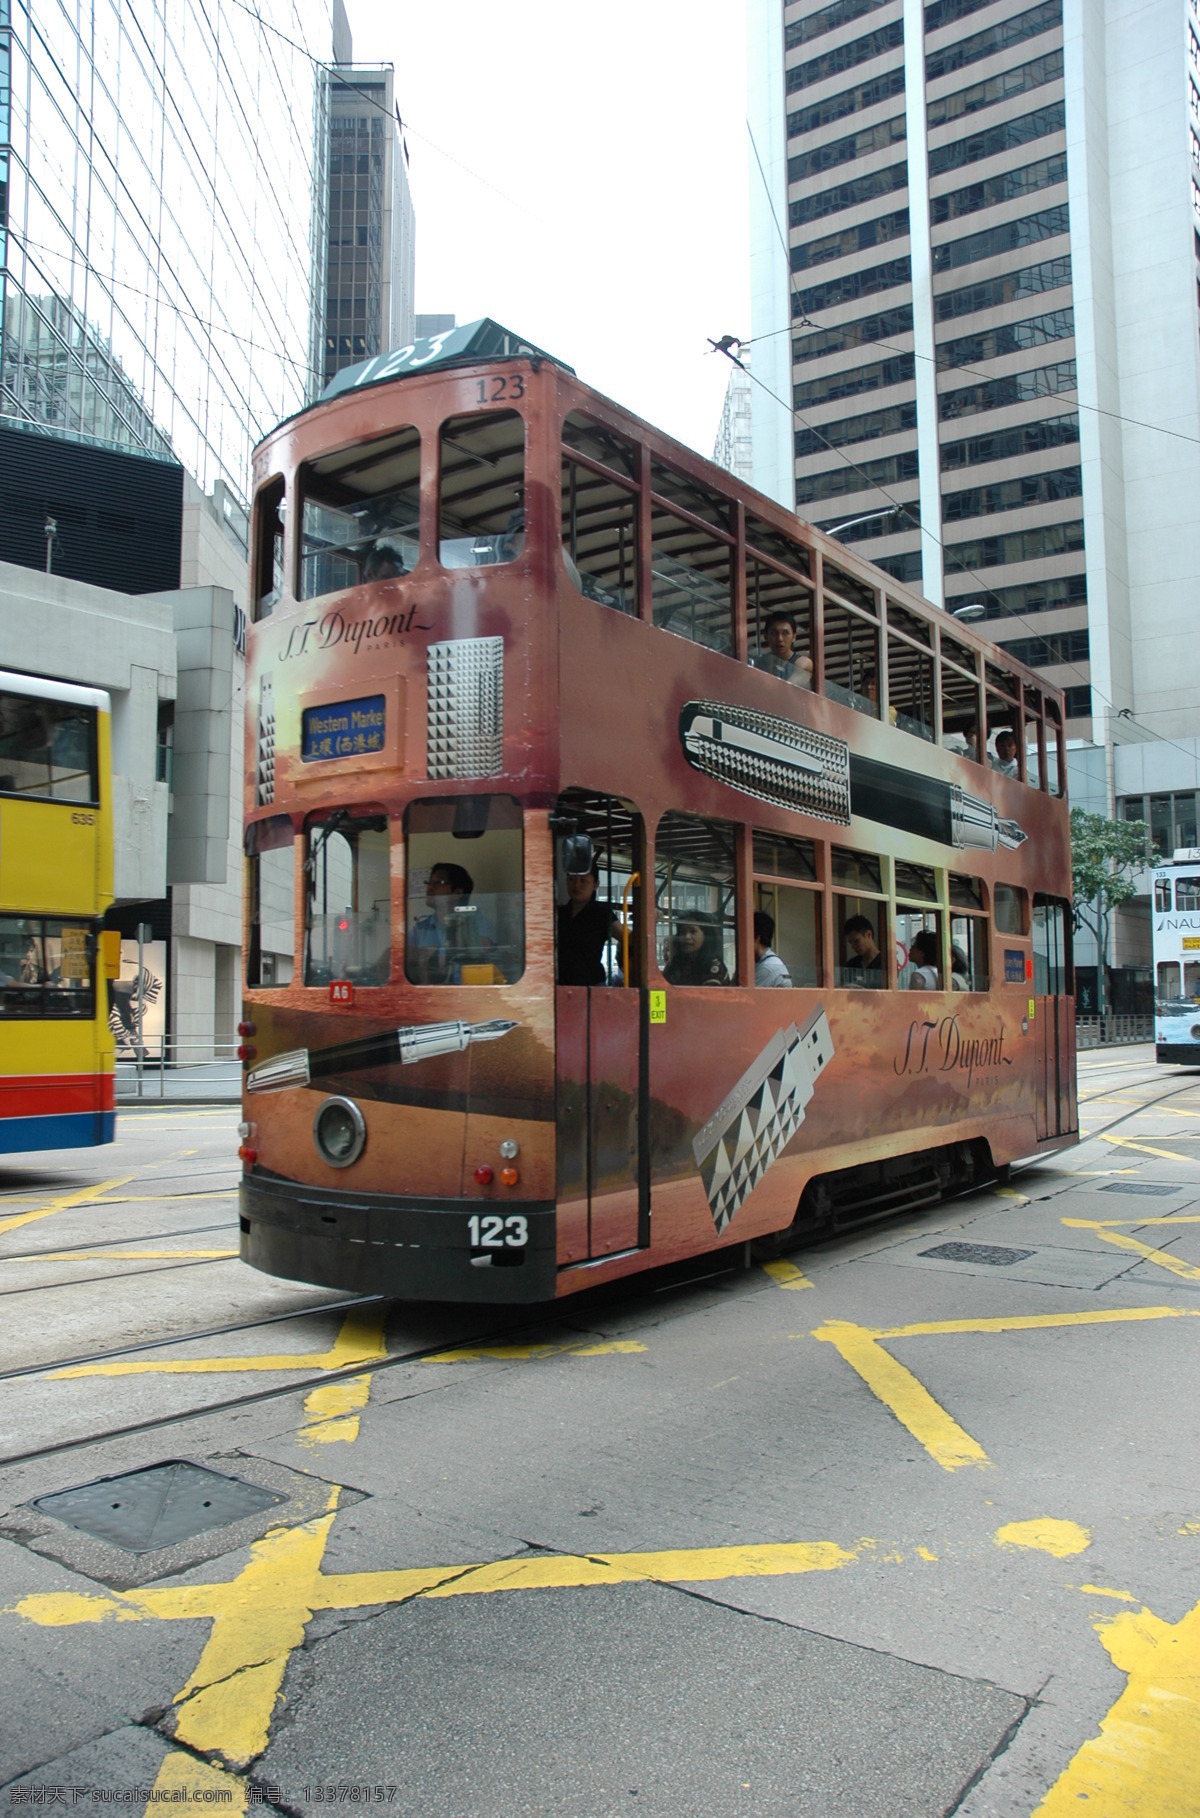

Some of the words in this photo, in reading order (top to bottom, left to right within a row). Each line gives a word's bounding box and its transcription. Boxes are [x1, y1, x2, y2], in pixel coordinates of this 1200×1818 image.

[354, 328, 458, 386] 123
[475, 374, 525, 403] 123
[318, 603, 434, 655] Dupont
[309, 715, 348, 734] Western
[71, 812, 95, 826] 635
[333, 985, 348, 999] A6
[651, 1010, 665, 1019] EXIT
[938, 1013, 1013, 1088] Dupont
[467, 1215, 529, 1247] 123
